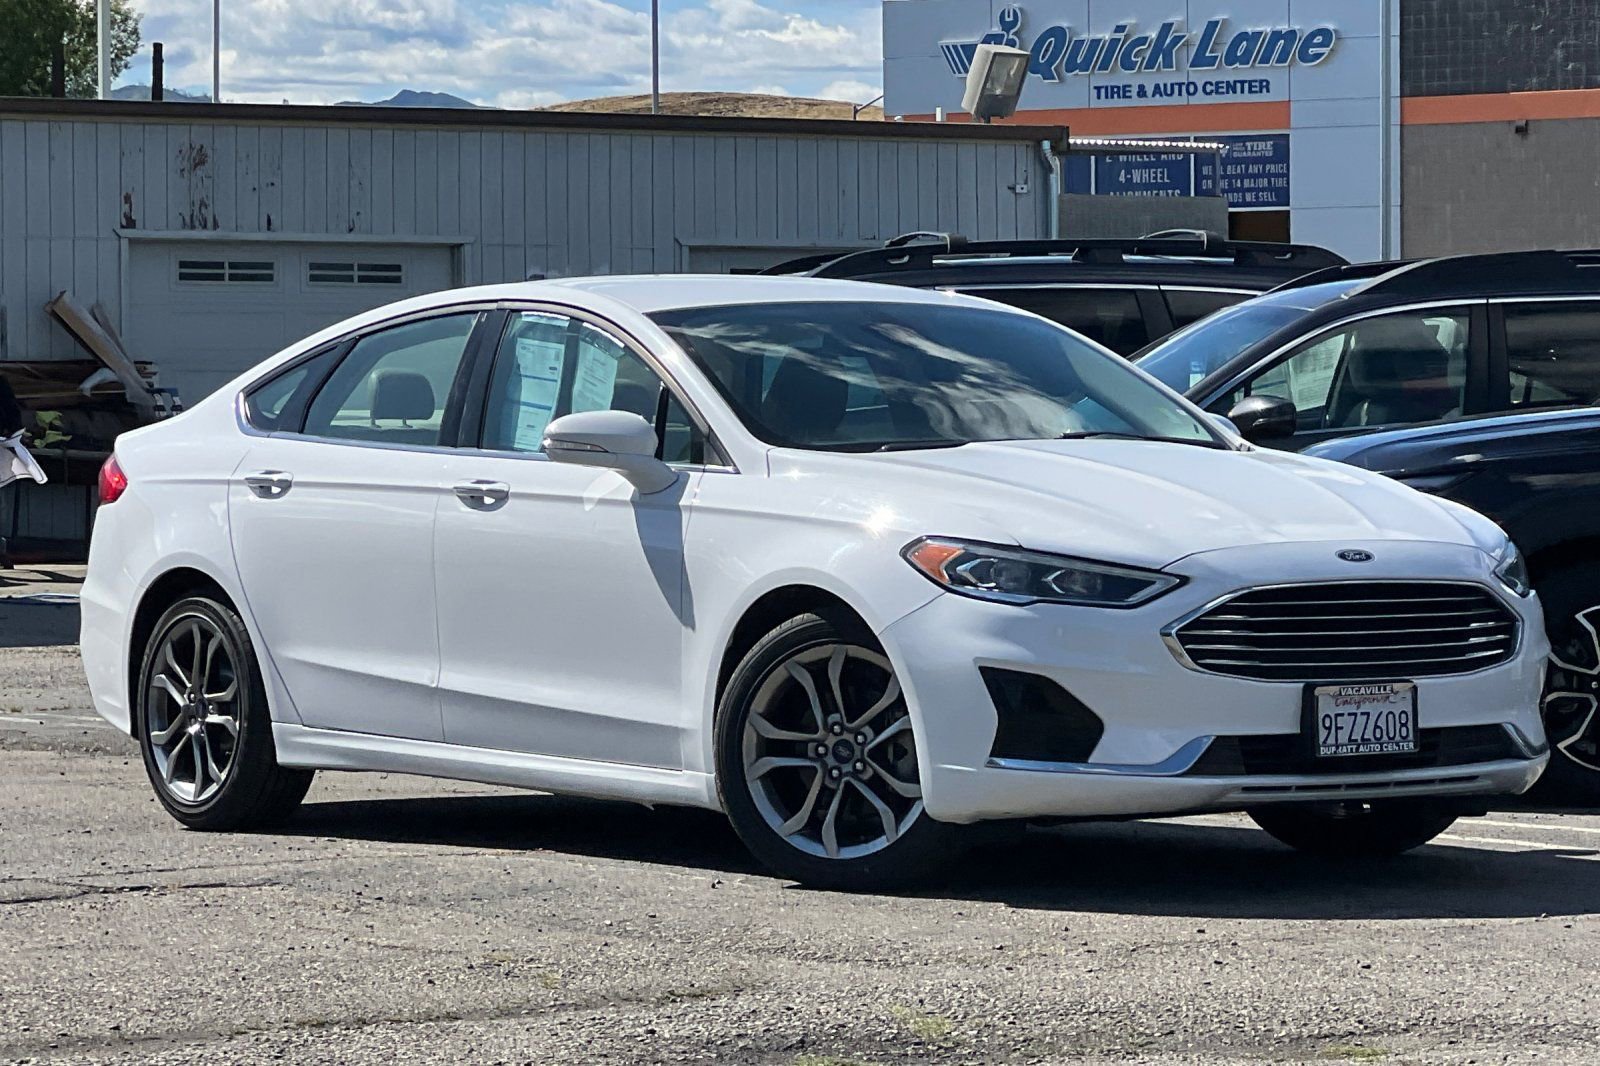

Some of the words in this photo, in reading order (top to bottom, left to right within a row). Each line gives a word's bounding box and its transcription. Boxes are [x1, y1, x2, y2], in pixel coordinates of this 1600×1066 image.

[1028, 19, 1187, 82] Quick
[1189, 16, 1336, 71] Lane
[1094, 84, 1132, 100] TIRE
[1137, 84, 1148, 98] &
[1152, 81, 1198, 97] AUTO
[1202, 79, 1270, 96] CENTER
[1245, 141, 1274, 151] TIRE
[1227, 164, 1245, 175] BEAT
[1248, 164, 1263, 174] ANY
[1265, 163, 1288, 174] PRICE
[1118, 168, 1170, 183] 4-WHEEL
[1202, 179, 1212, 190] ON
[1232, 179, 1241, 188] 14
[1243, 178, 1268, 188] MAJOR
[1271, 177, 1288, 188] TIRE
[1245, 192, 1256, 202] WE
[1259, 191, 1277, 202] SELL
[1340, 686, 1392, 696] VACAVILLE
[1321, 710, 1410, 745] 9FZZ608
[1359, 744, 1381, 752] AUTO
